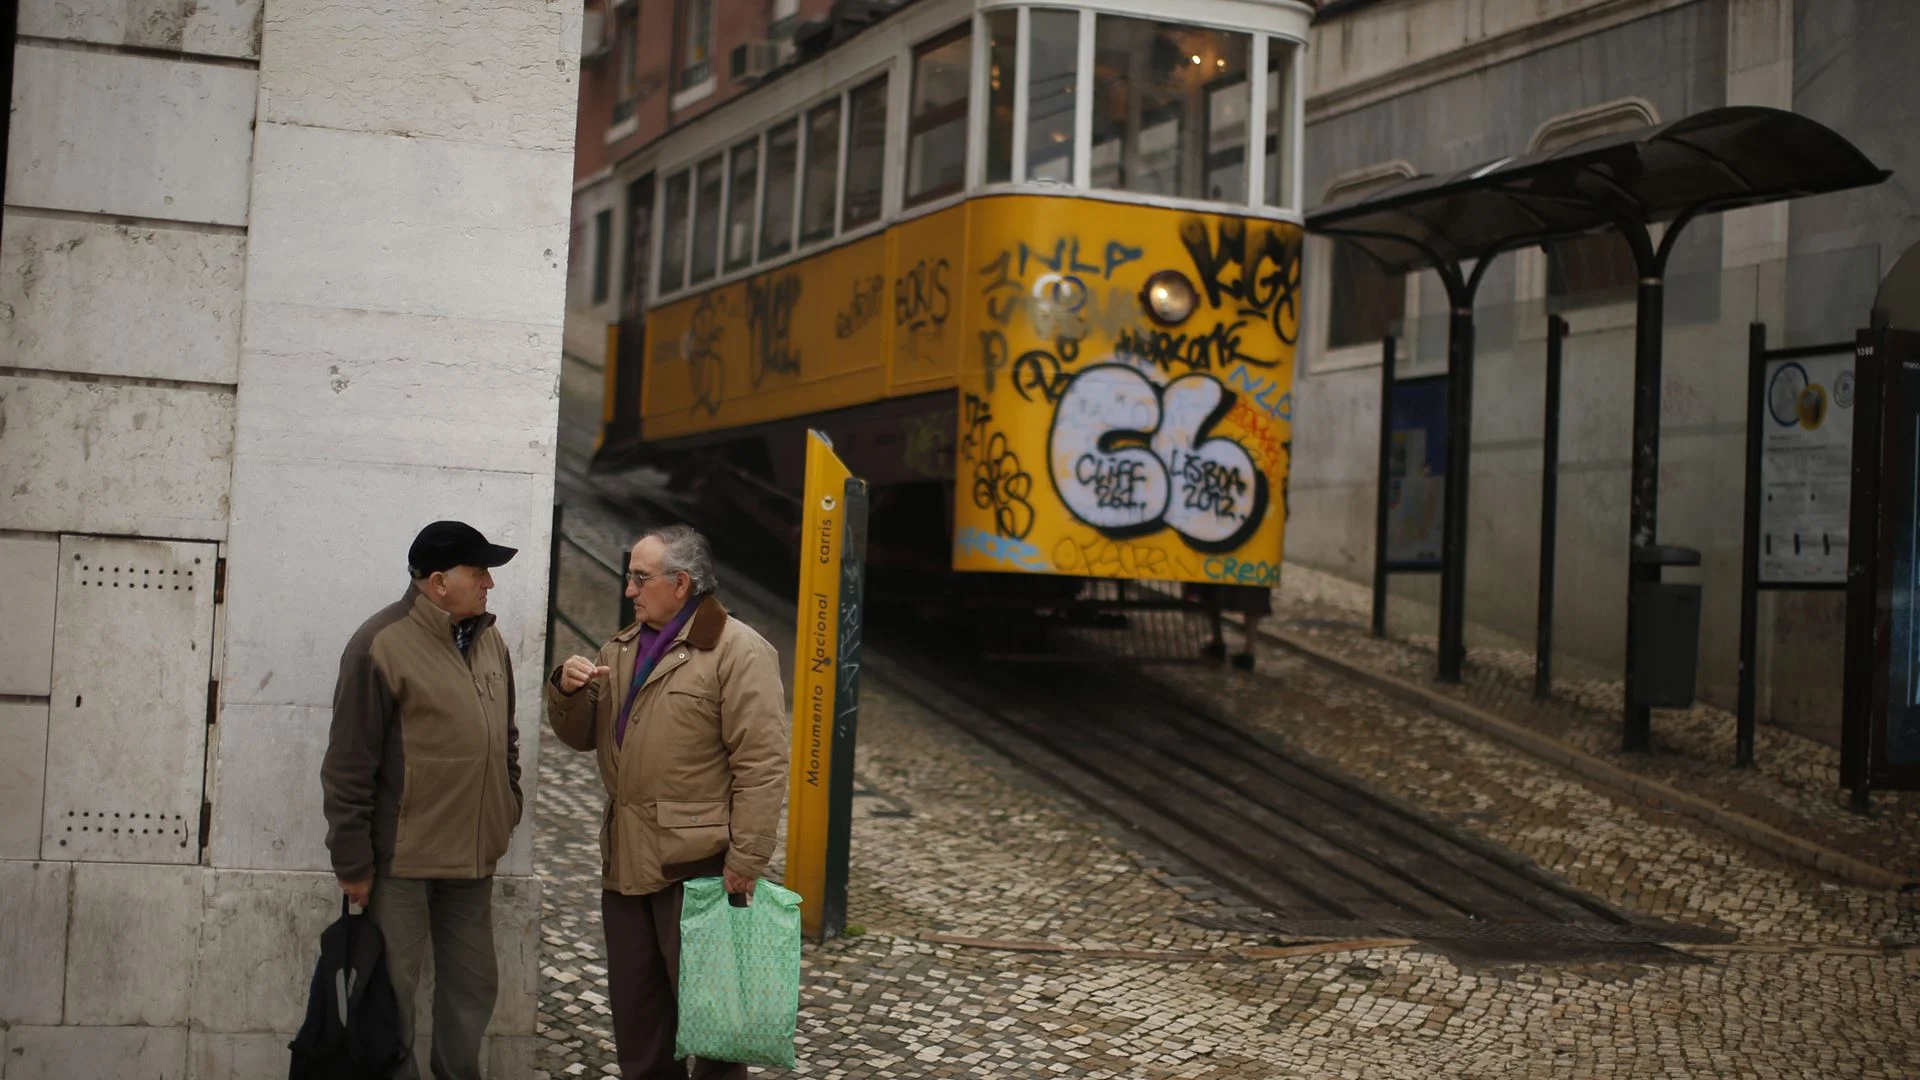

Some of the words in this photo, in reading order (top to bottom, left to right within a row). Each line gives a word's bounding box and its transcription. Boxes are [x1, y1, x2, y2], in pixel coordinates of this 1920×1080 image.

[819, 518, 832, 565] carris
[811, 593, 829, 674] Nacional
[806, 684, 824, 788] Monumento
